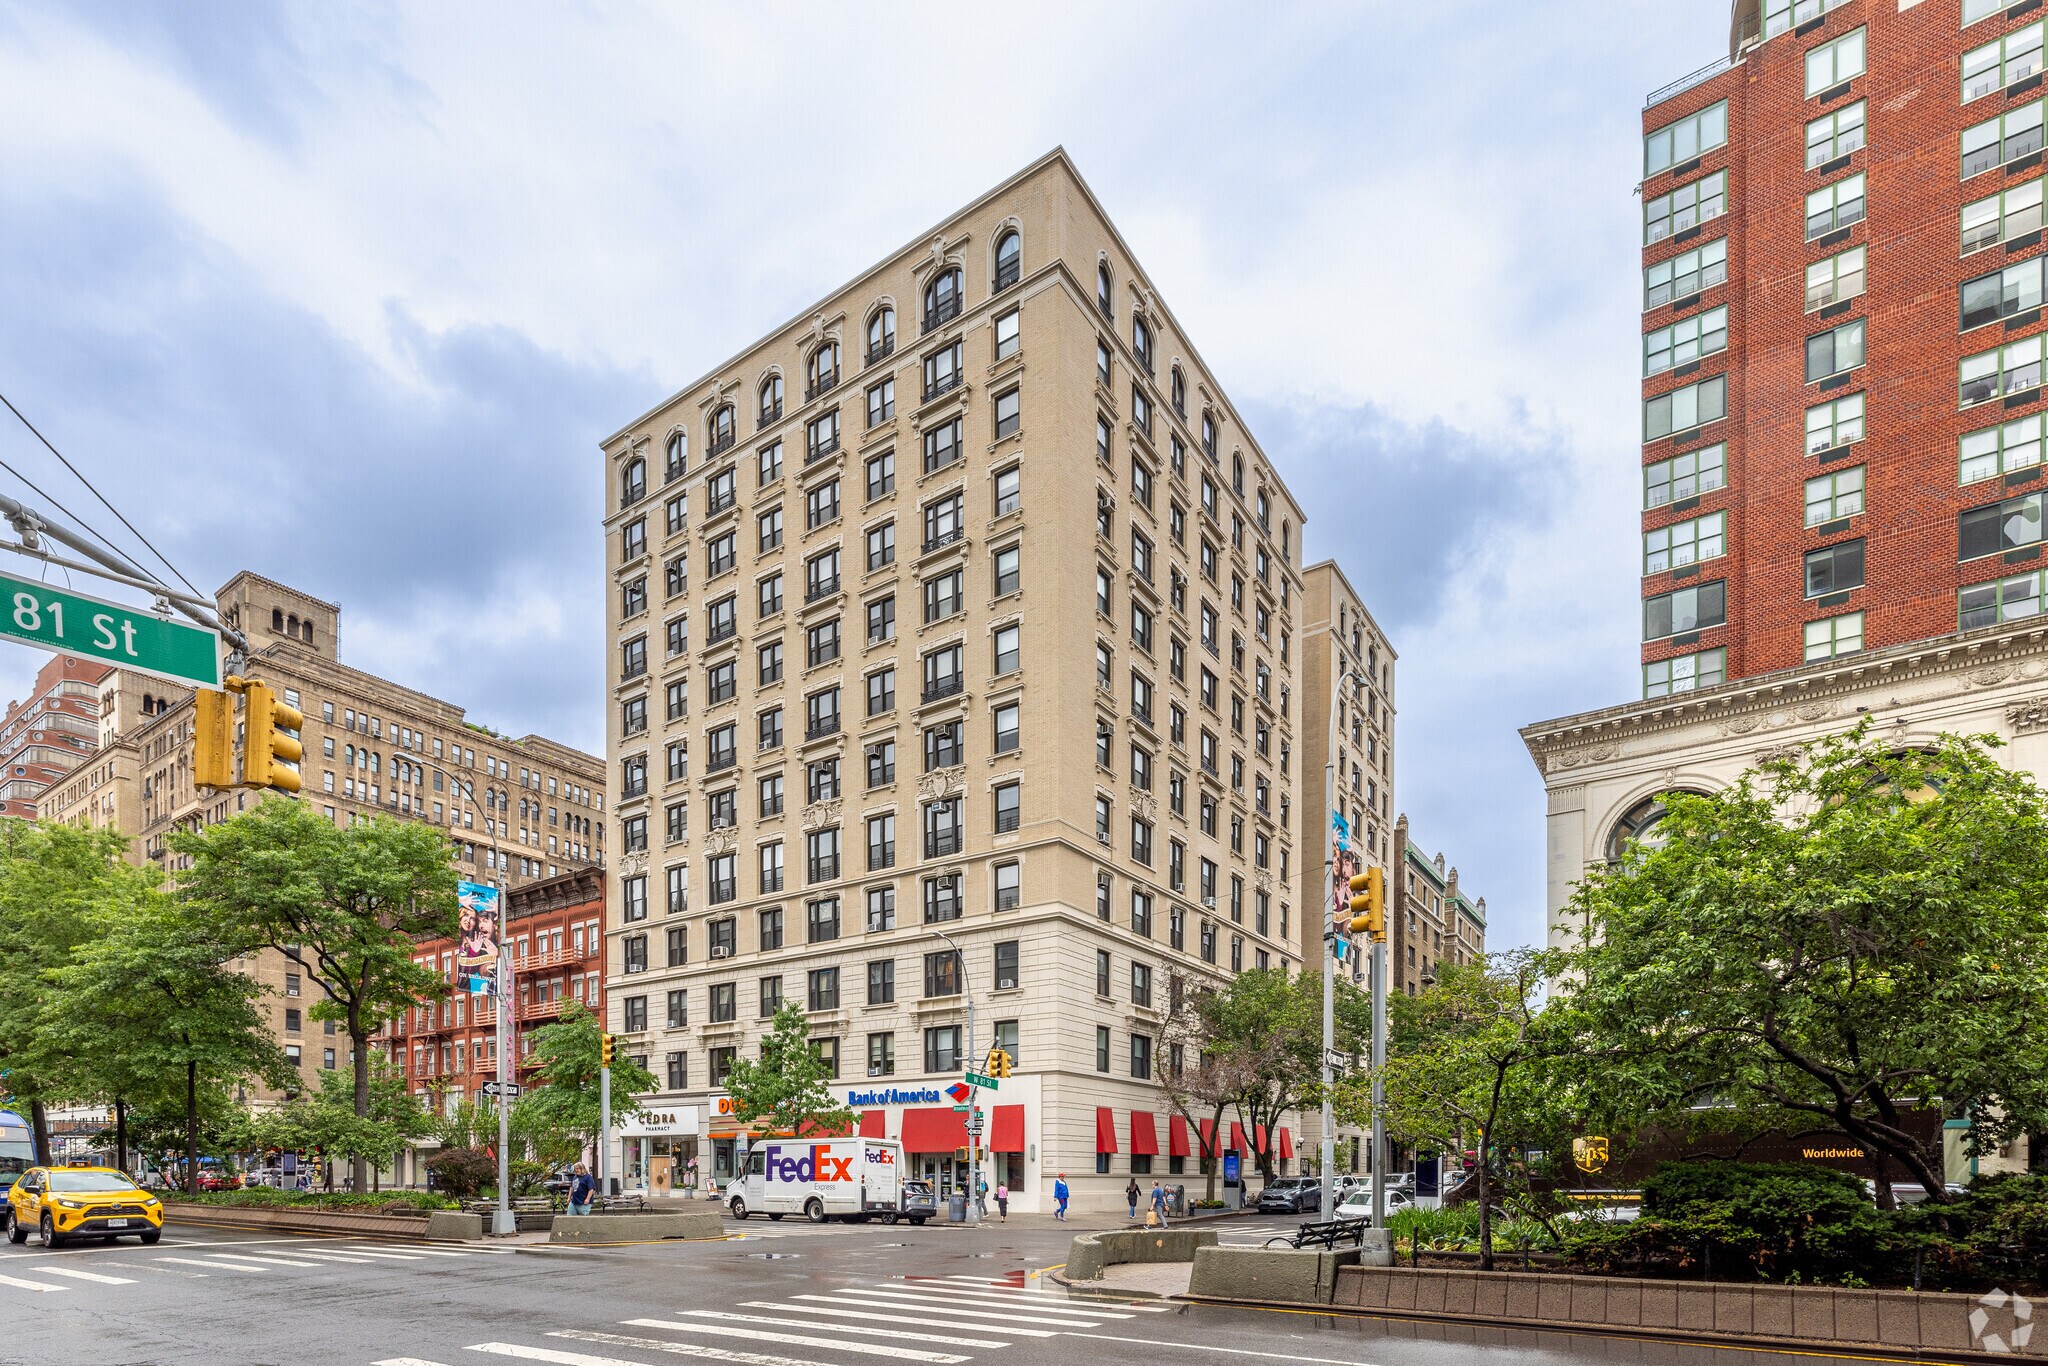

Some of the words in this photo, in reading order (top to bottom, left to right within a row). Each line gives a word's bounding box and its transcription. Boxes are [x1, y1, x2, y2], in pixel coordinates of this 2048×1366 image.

[13, 592, 64, 638] 81
[93, 613, 138, 657] St
[471, 890, 486, 899] NYC
[979, 1077, 986, 1086] 81
[848, 1089, 878, 1105] Bank
[878, 1088, 890, 1104] of
[890, 1086, 940, 1103] America
[638, 1113, 677, 1125] CEDRA
[864, 1147, 895, 1165] FedEx
[1802, 1147, 1865, 1158] Worldwide
[765, 1144, 854, 1183] FedEx
[814, 1182, 836, 1192] Express
